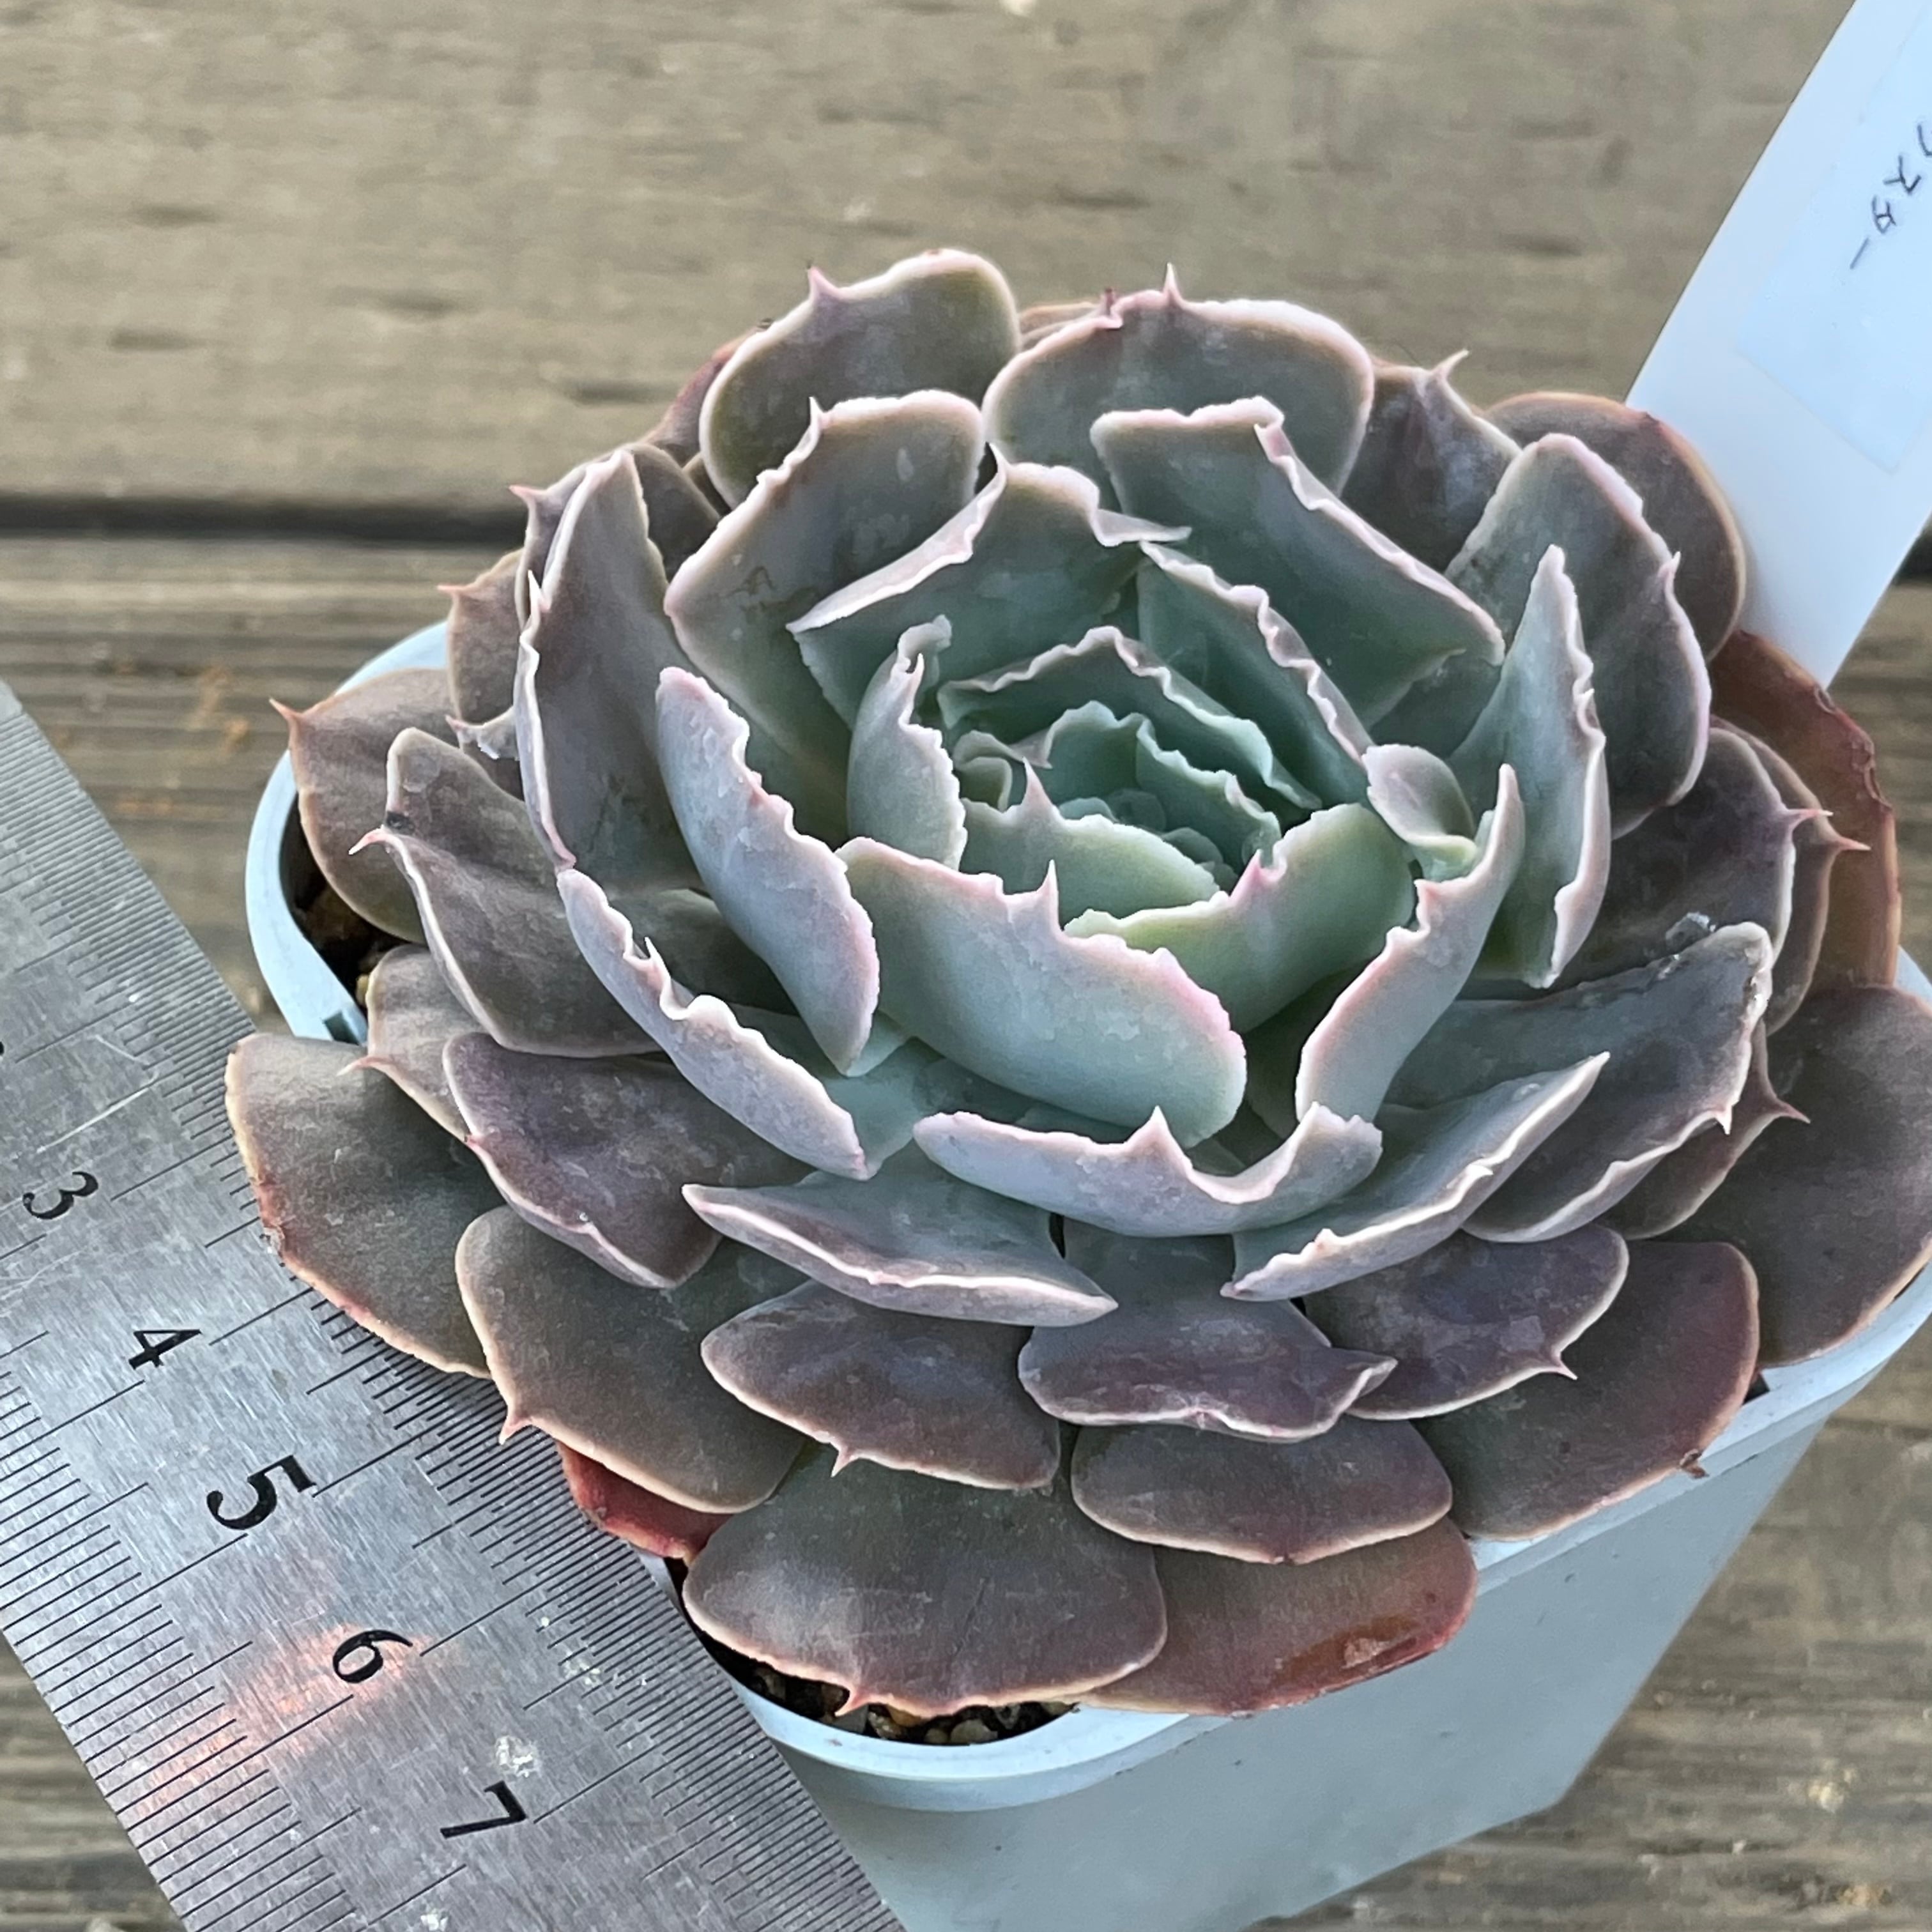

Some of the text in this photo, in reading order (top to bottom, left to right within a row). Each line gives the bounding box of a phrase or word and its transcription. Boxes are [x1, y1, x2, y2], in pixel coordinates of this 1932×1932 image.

[22, 1170, 99, 1220] 3
[128, 1328, 203, 1370] 4
[206, 1454, 318, 1531] 5
[332, 1629, 413, 1683] 6
[440, 1780, 527, 1839] 7
